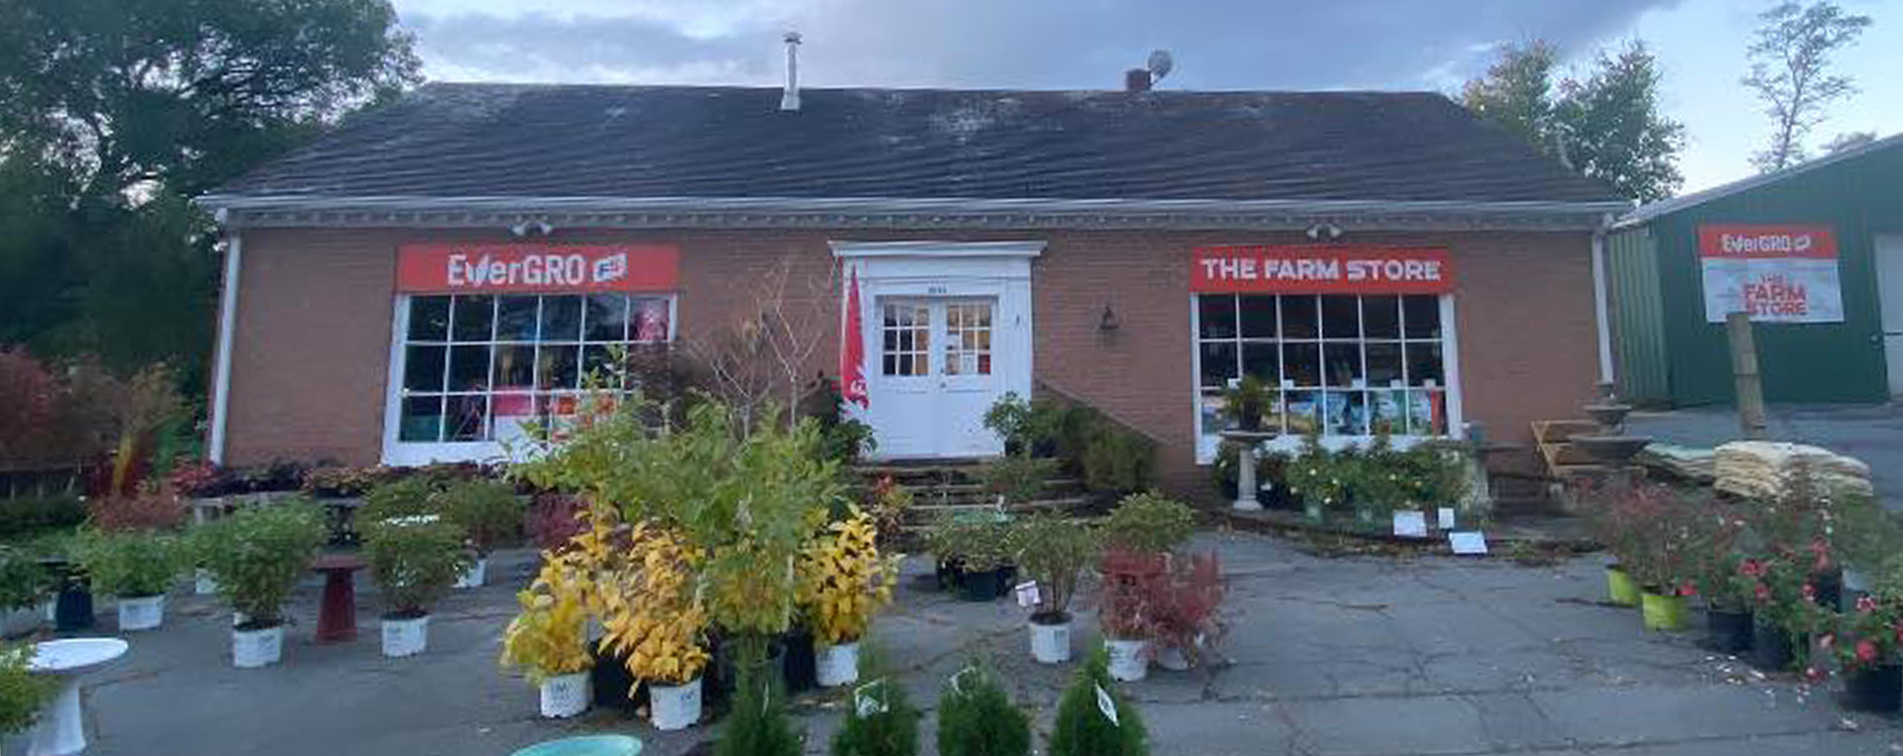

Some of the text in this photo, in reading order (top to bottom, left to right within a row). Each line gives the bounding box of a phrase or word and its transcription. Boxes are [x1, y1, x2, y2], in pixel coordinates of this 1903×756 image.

[447, 253, 586, 288] EverGRO
[1200, 258, 1442, 281] THE FARM STORE
[1744, 284, 1806, 301] FARM
[1745, 301, 1807, 316] STORE
